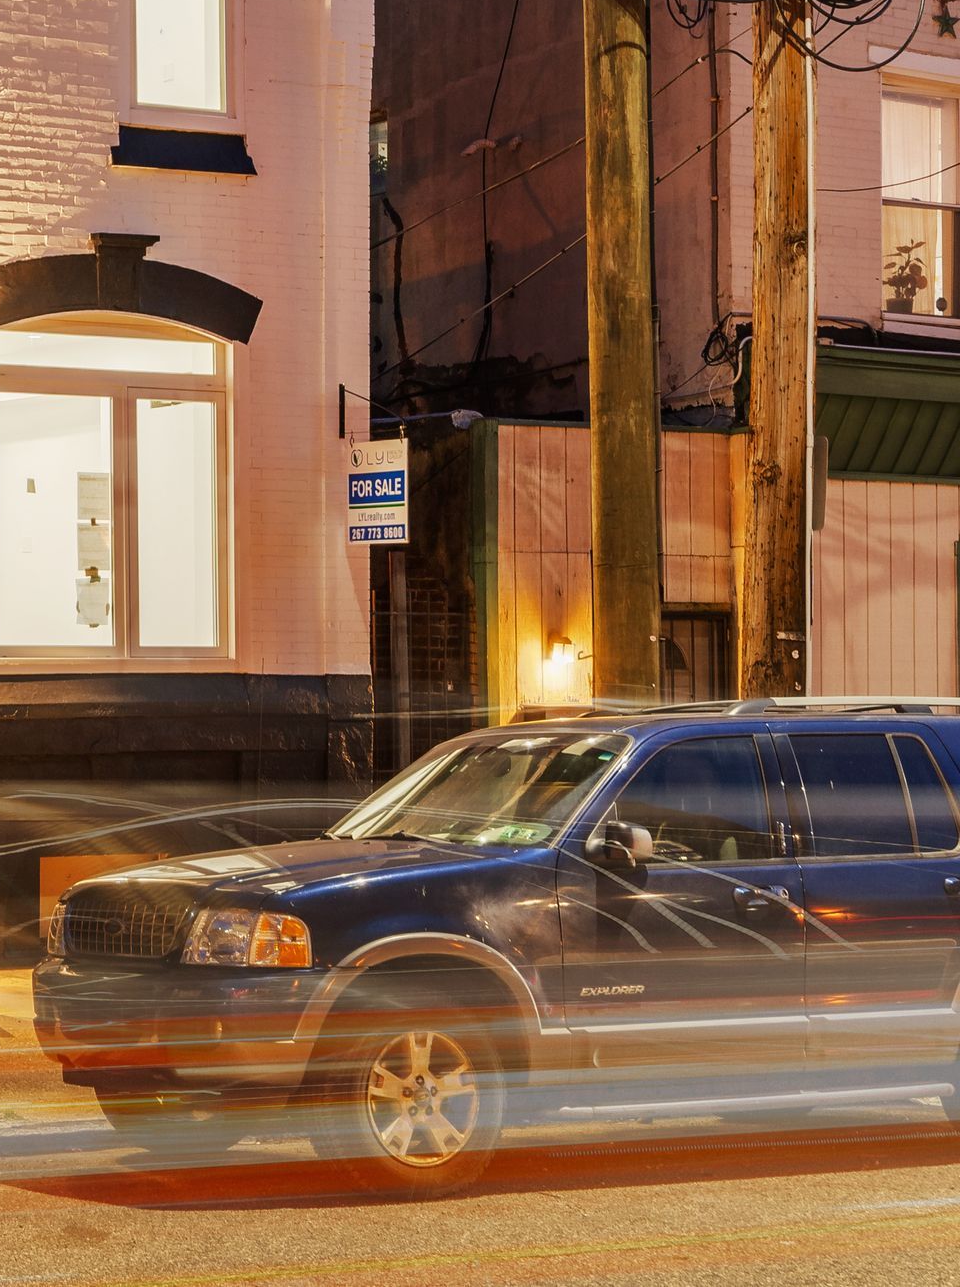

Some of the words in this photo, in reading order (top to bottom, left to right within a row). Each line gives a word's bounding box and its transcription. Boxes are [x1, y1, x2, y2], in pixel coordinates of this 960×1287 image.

[351, 480, 372, 497] FOR
[375, 477, 402, 496] SALE
[358, 512, 395, 522] LYLrealty.com
[352, 528, 365, 540] 267
[367, 527, 381, 539] 773
[580, 985, 645, 996] EXPLORER
